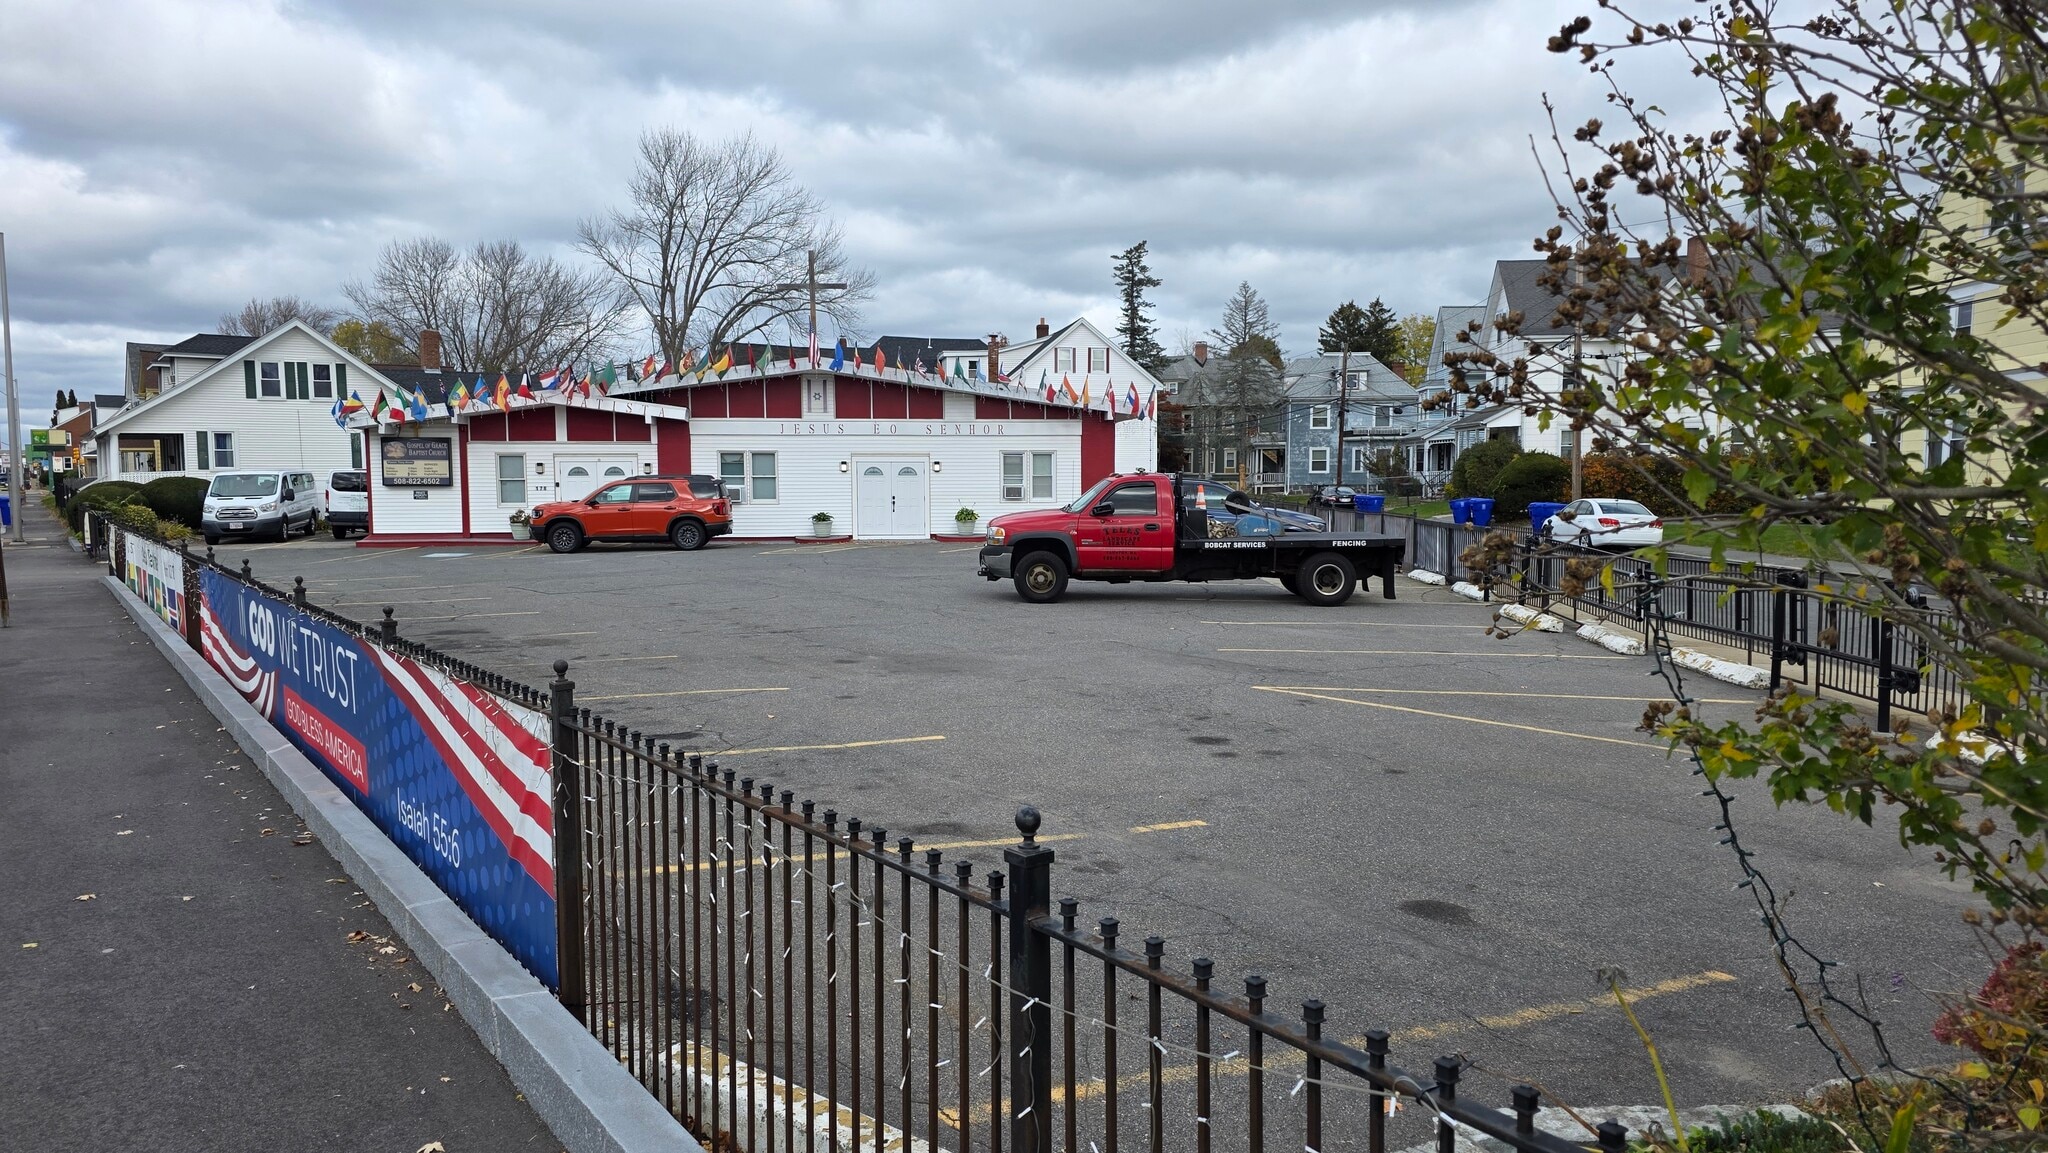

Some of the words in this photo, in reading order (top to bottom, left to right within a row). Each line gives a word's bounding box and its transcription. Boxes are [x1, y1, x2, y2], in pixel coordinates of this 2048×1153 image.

[780, 423, 844, 434] JESUS
[925, 424, 1004, 435] SENHOR
[250, 600, 275, 658] GOD
[276, 614, 300, 676] WE
[300, 626, 358, 715] TRUST
[286, 698, 302, 726] GOD
[301, 710, 324, 746] BLESS
[325, 728, 364, 783] AMERICA
[397, 787, 431, 844] Isaiah
[433, 812, 460, 869] 55:6
